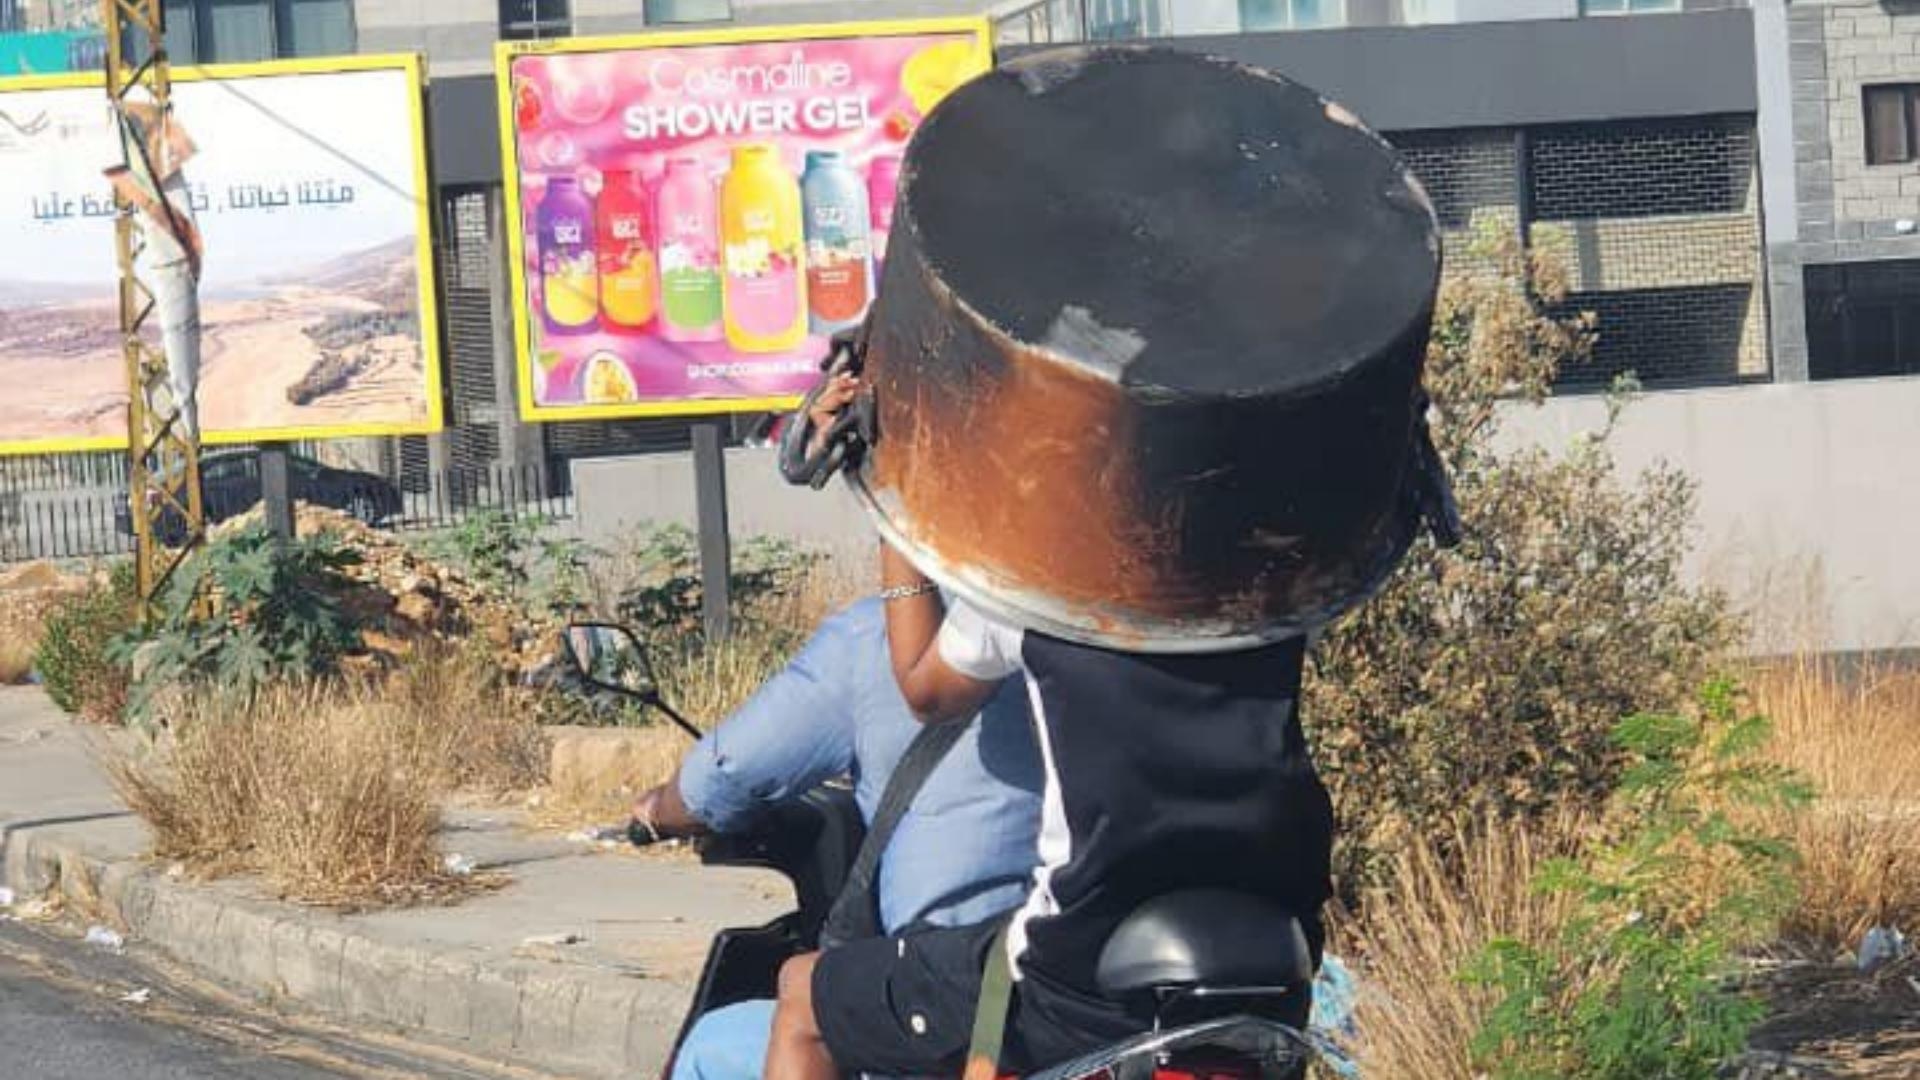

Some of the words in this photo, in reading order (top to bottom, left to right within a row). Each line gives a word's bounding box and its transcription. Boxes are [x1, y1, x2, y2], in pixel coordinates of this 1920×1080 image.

[651, 50, 852, 95] Cosmaline
[624, 98, 797, 139] SHOWER
[803, 92, 880, 129] GEL
